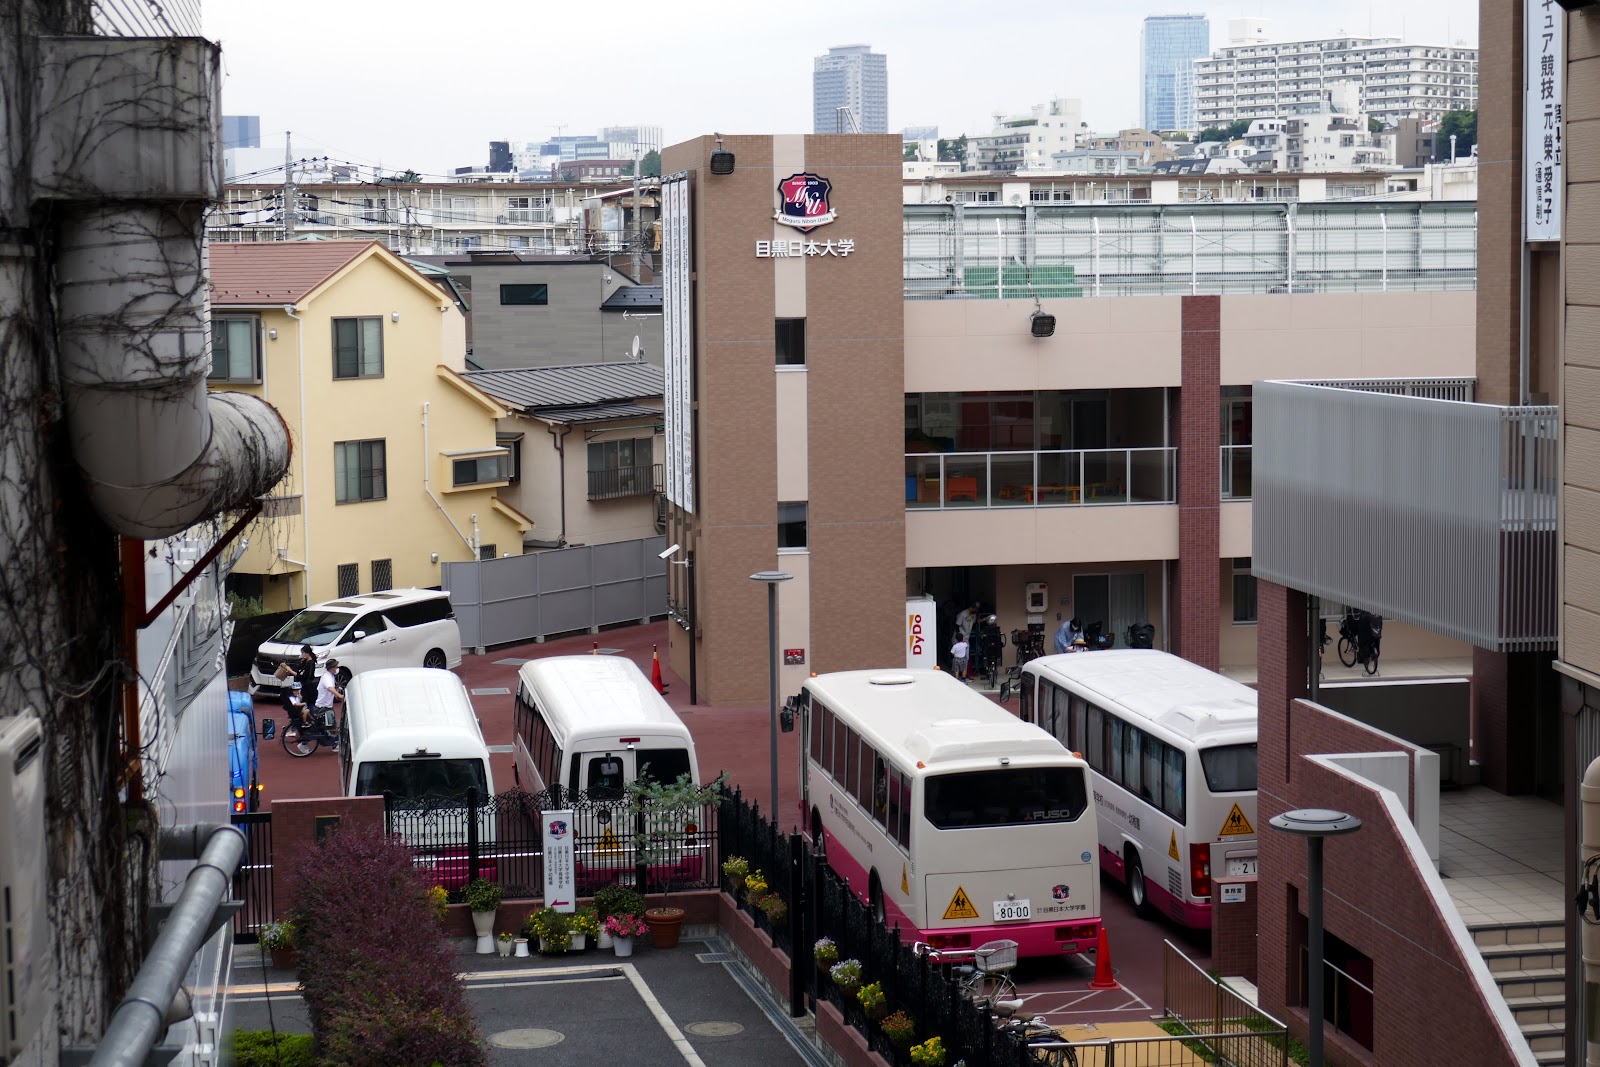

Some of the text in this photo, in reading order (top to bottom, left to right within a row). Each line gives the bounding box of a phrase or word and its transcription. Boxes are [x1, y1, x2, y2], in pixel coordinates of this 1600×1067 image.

[782, 216, 800, 224] Meguro
[756, 239, 855, 258] 目黒日本大学
[912, 614, 925, 655] DyDo
[1033, 809, 1070, 820] FUSO
